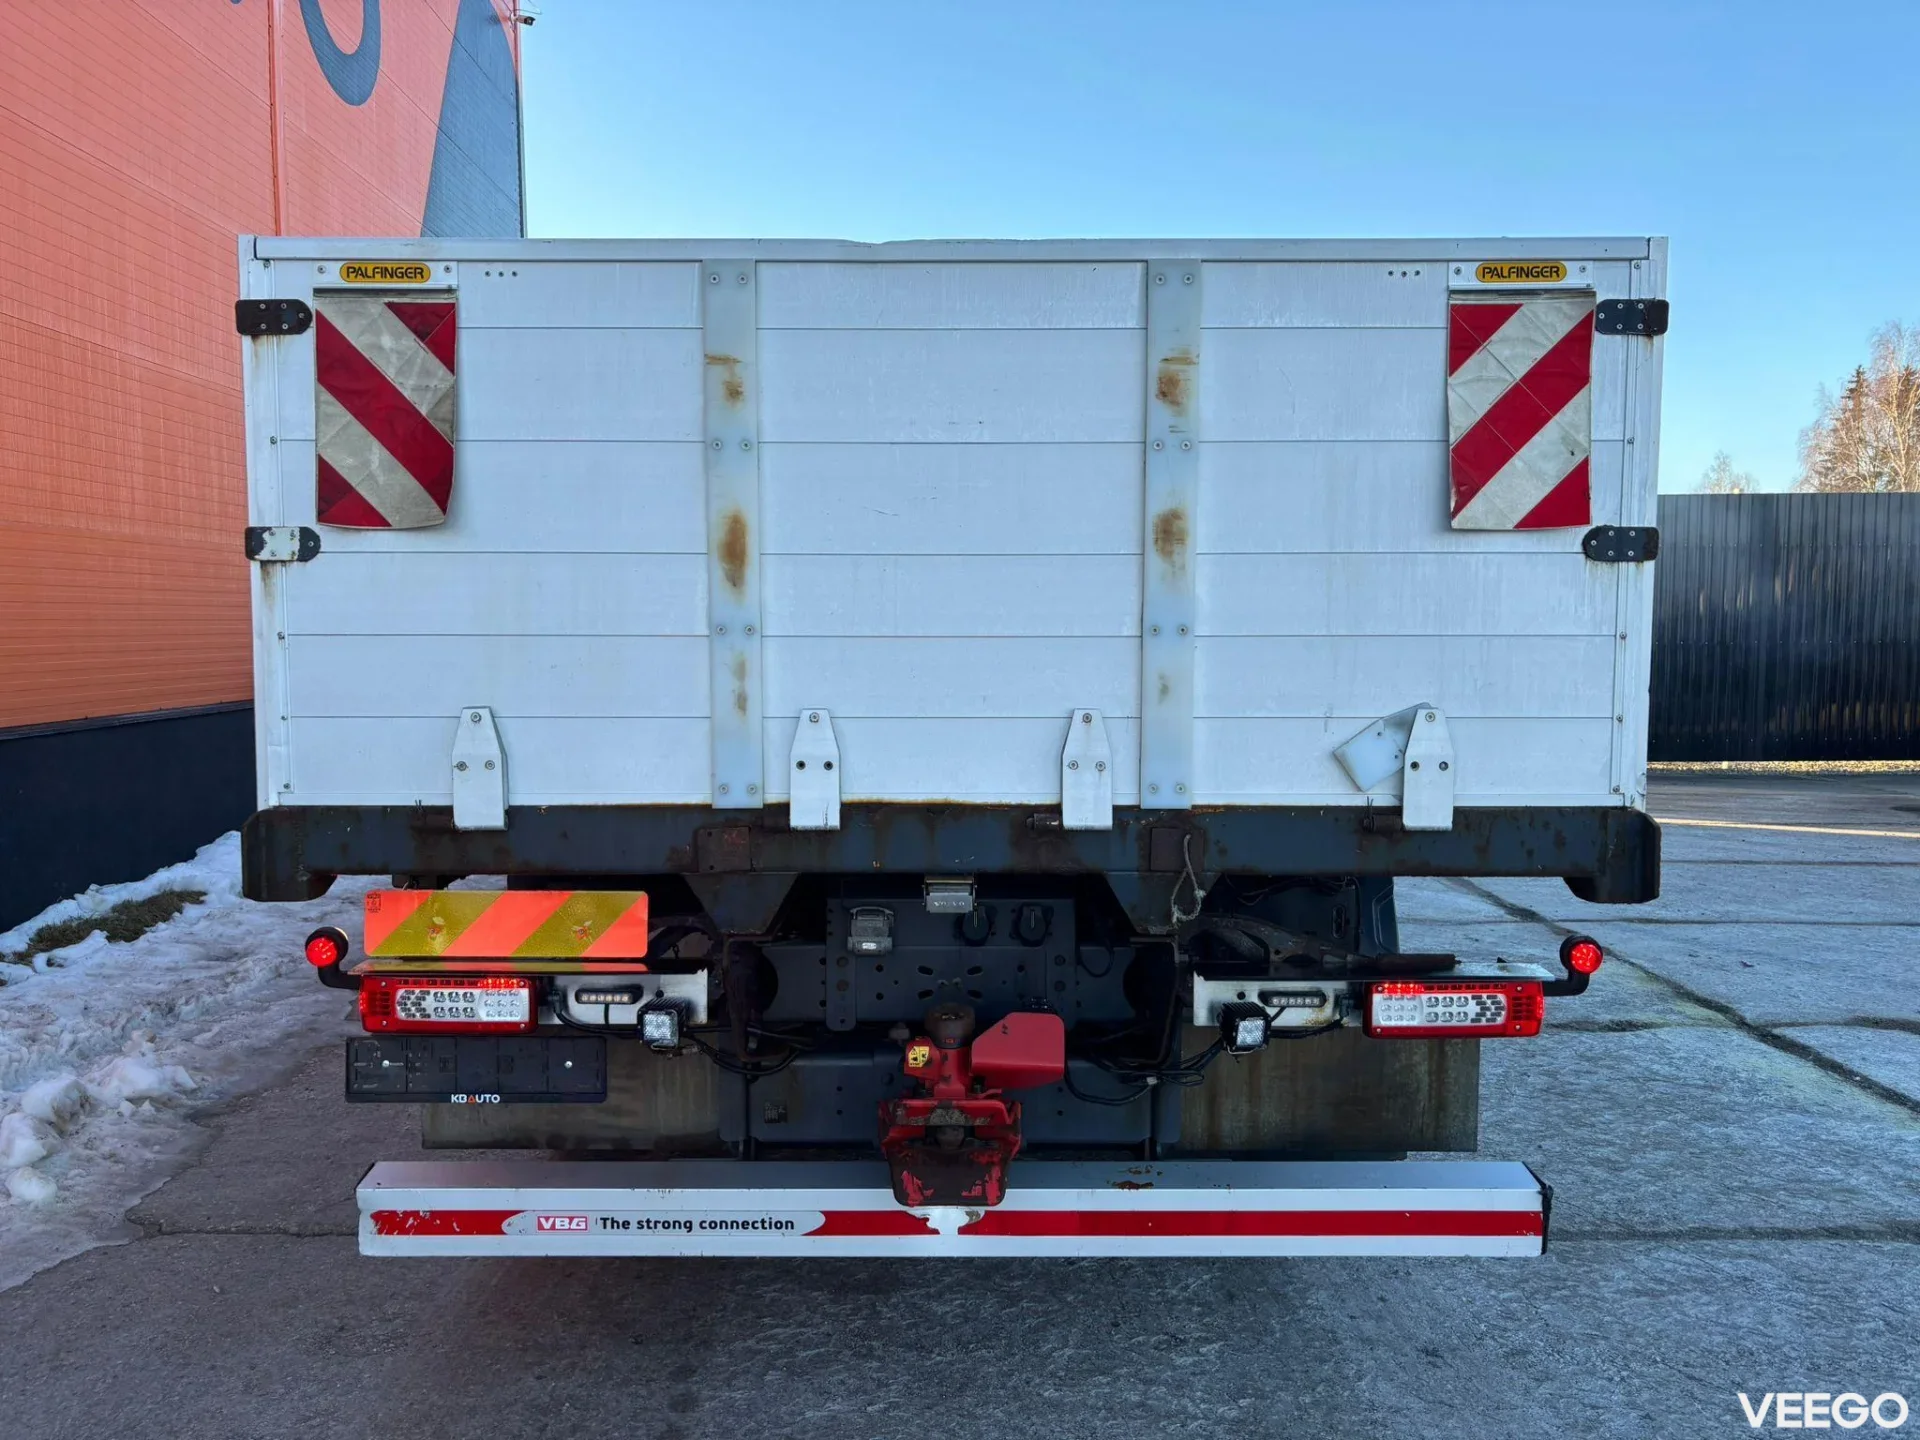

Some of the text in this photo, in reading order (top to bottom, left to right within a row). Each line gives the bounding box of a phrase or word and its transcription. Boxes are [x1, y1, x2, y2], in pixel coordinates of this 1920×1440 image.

[346, 266, 424, 279] PALFINGER
[1482, 266, 1560, 279] PALFINGER
[539, 1217, 587, 1230] VBG
[600, 1217, 795, 1234] The strong connection
